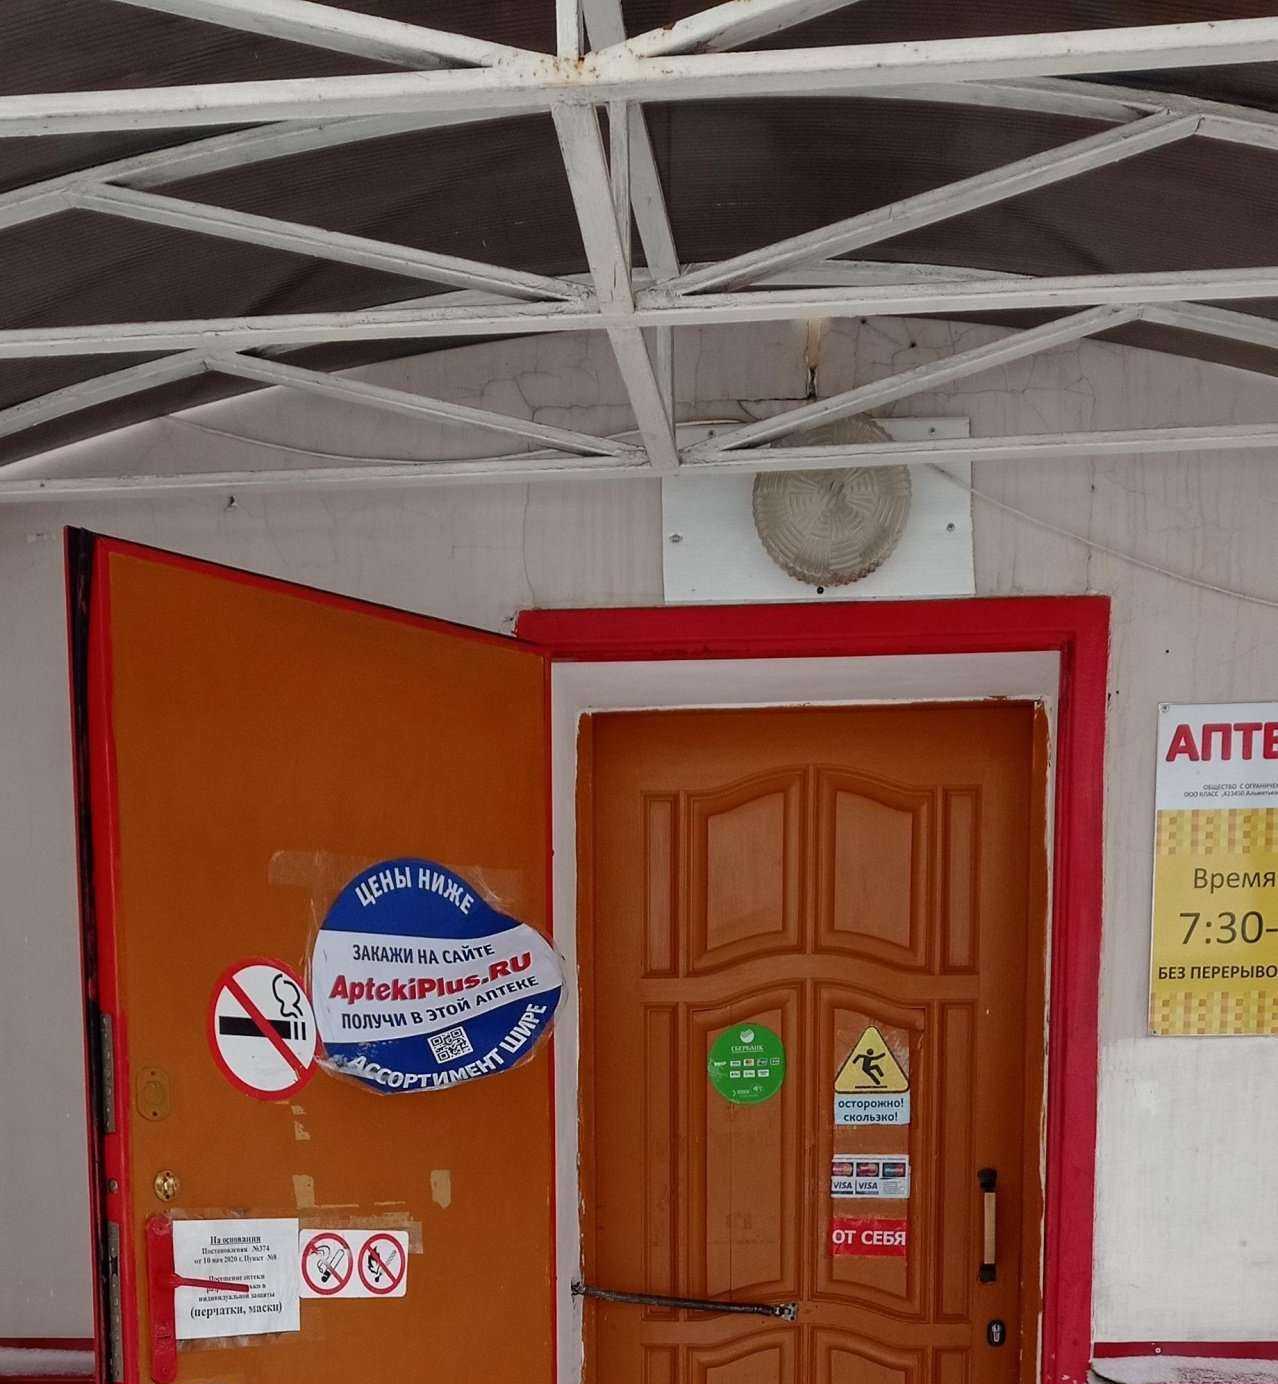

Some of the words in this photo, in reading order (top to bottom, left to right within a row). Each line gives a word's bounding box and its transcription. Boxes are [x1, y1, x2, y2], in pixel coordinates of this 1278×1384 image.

[1193, 867, 1276, 894] Время
[355, 867, 412, 907] ЦЕНЫ
[418, 868, 475, 915] НИЖЕ
[352, 944, 414, 964] ЗАКАЖИ
[418, 948, 440, 965] НА
[442, 943, 495, 965] САЙТЕ
[328, 951, 532, 1004] AptekiPlus.RU
[1158, 966, 1186, 980] БЕЗ
[1190, 965, 1278, 979] ПЕРЕРЫВО
[341, 1012, 407, 1029] ПОЛУЧИ
[412, 1011, 423, 1025] В
[428, 1000, 473, 1023] ЭТОЙ
[475, 976, 540, 1007] АПТЕКЕ
[349, 1048, 505, 1089] АССОРТИМЕНТ
[500, 1003, 548, 1055] ШИРЕ
[838, 1098, 904, 1110] осторожно!
[843, 1112, 898, 1122] скользко!
[833, 1181, 852, 1190] VISA
[858, 1181, 878, 1190] VISA
[210, 1236, 221, 1245] На
[223, 1236, 261, 1244] основании
[832, 1230, 856, 1245] ОТ
[861, 1230, 906, 1246] СЕБЯ
[190, 1306, 246, 1319] (перчатки,
[248, 1301, 282, 1314] маски)
